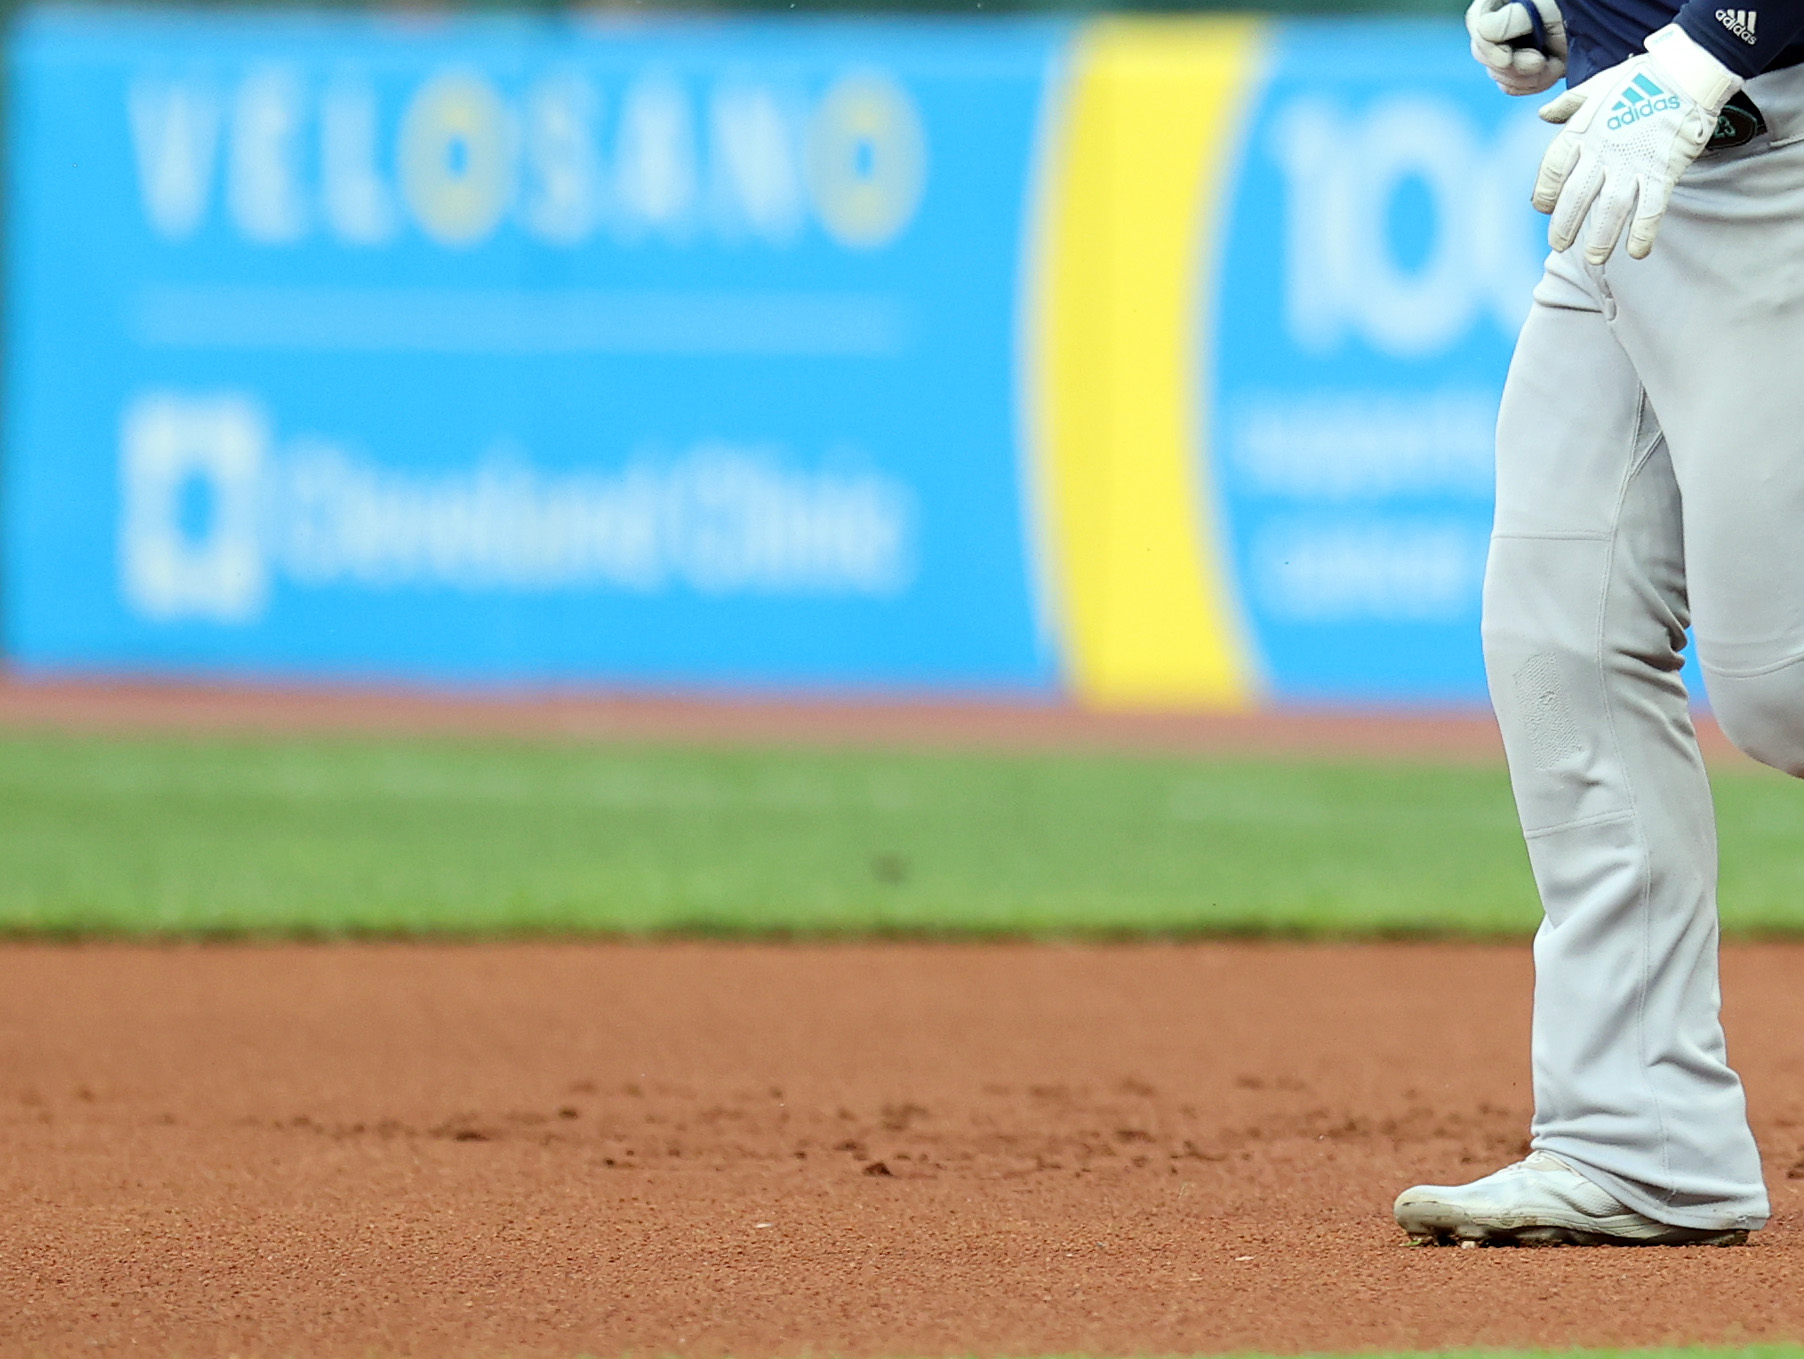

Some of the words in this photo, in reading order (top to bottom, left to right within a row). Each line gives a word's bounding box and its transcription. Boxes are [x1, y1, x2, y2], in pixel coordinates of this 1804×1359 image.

[1714, 8, 1757, 46] adidas
[1606, 94, 1681, 131] adidas
[130, 65, 926, 246] VELOSANO
